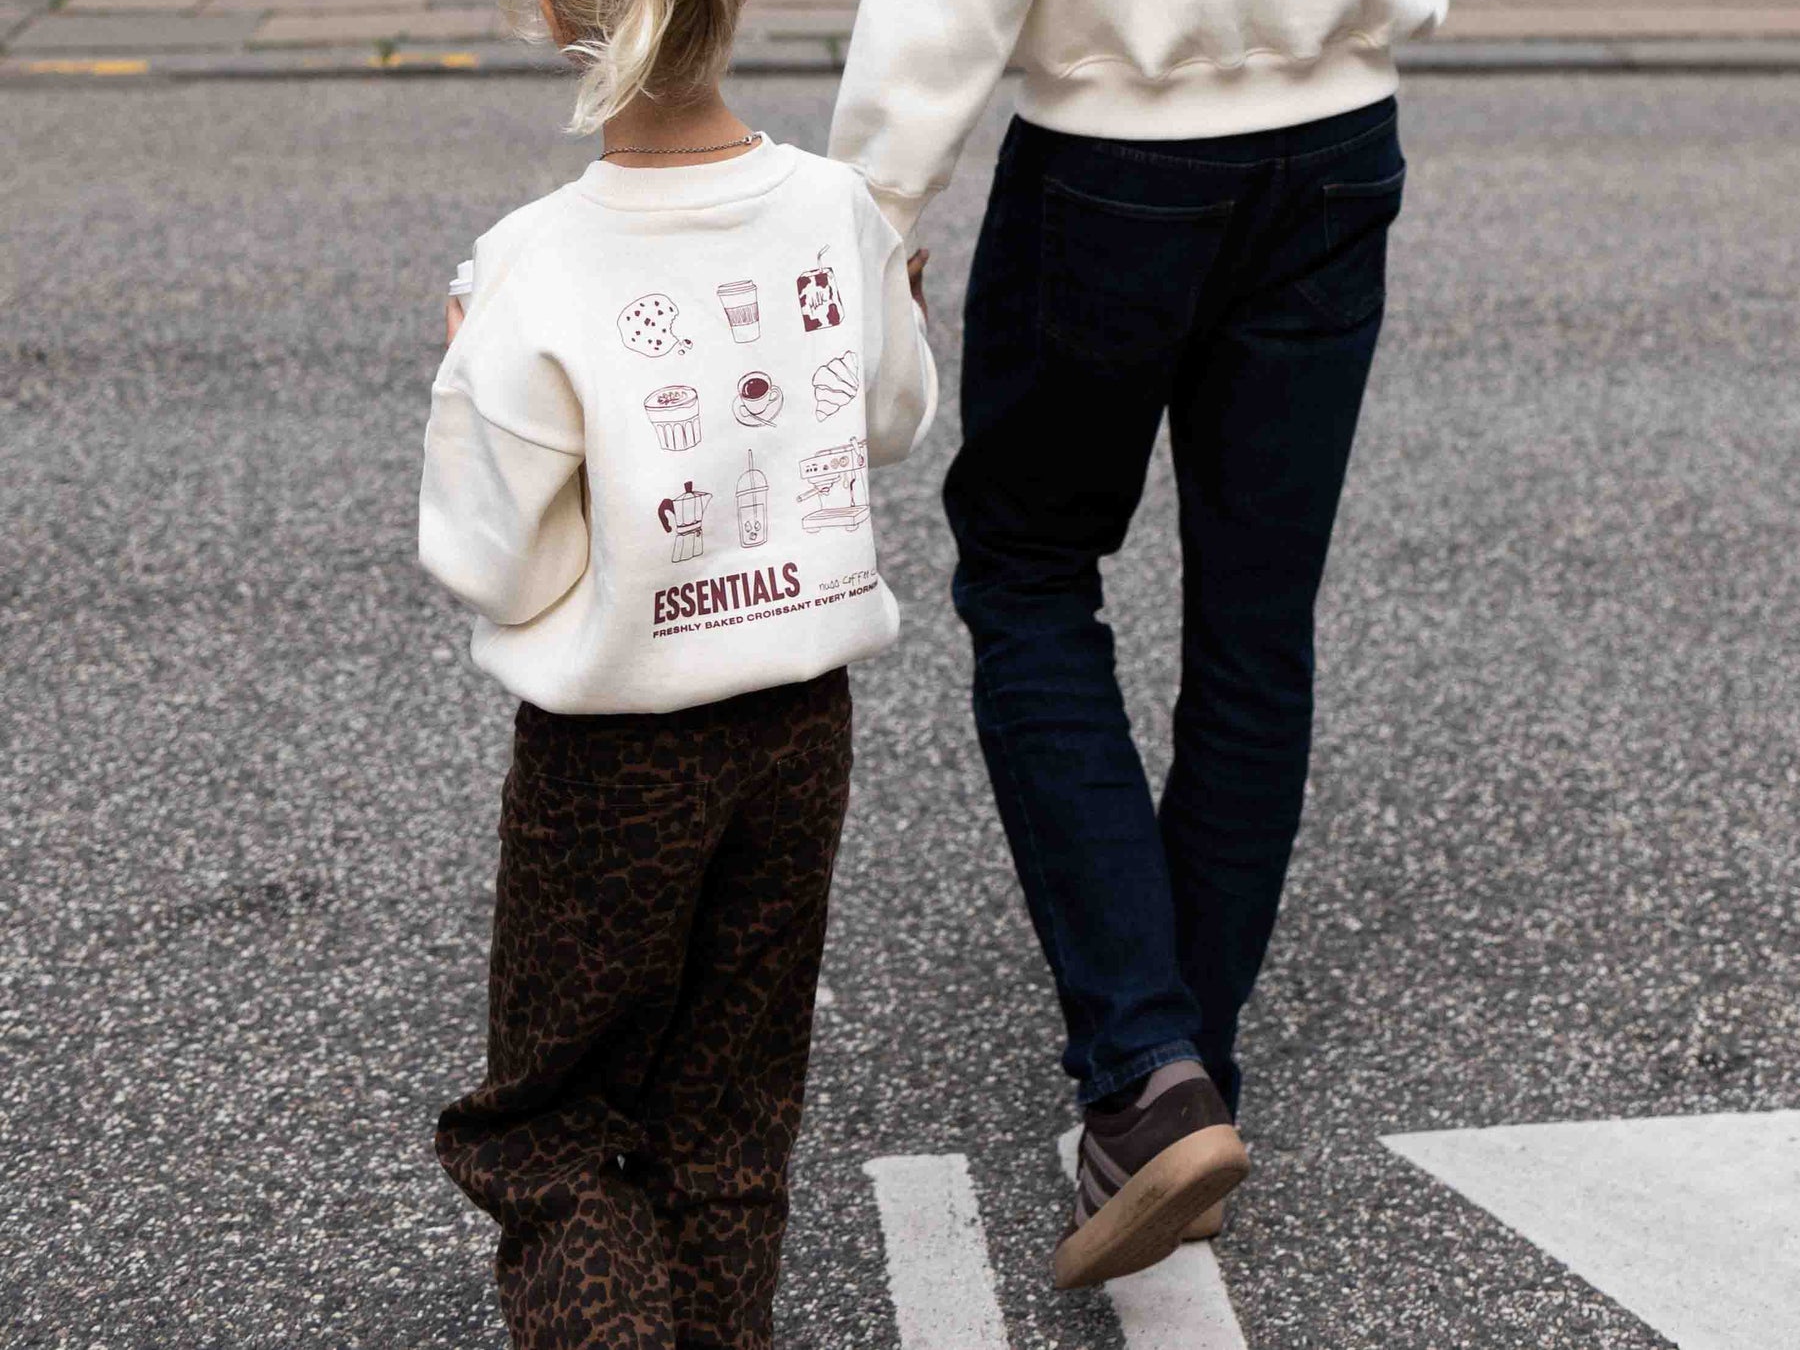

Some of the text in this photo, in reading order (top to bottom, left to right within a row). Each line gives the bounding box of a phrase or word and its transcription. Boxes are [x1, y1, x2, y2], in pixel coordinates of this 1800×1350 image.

[652, 622, 702, 639] FRESHLY
[705, 615, 744, 630] BAKED
[746, 600, 812, 622] CROISSANT
[814, 591, 847, 608] EVERY
[653, 561, 801, 625] ESSENTIALS
